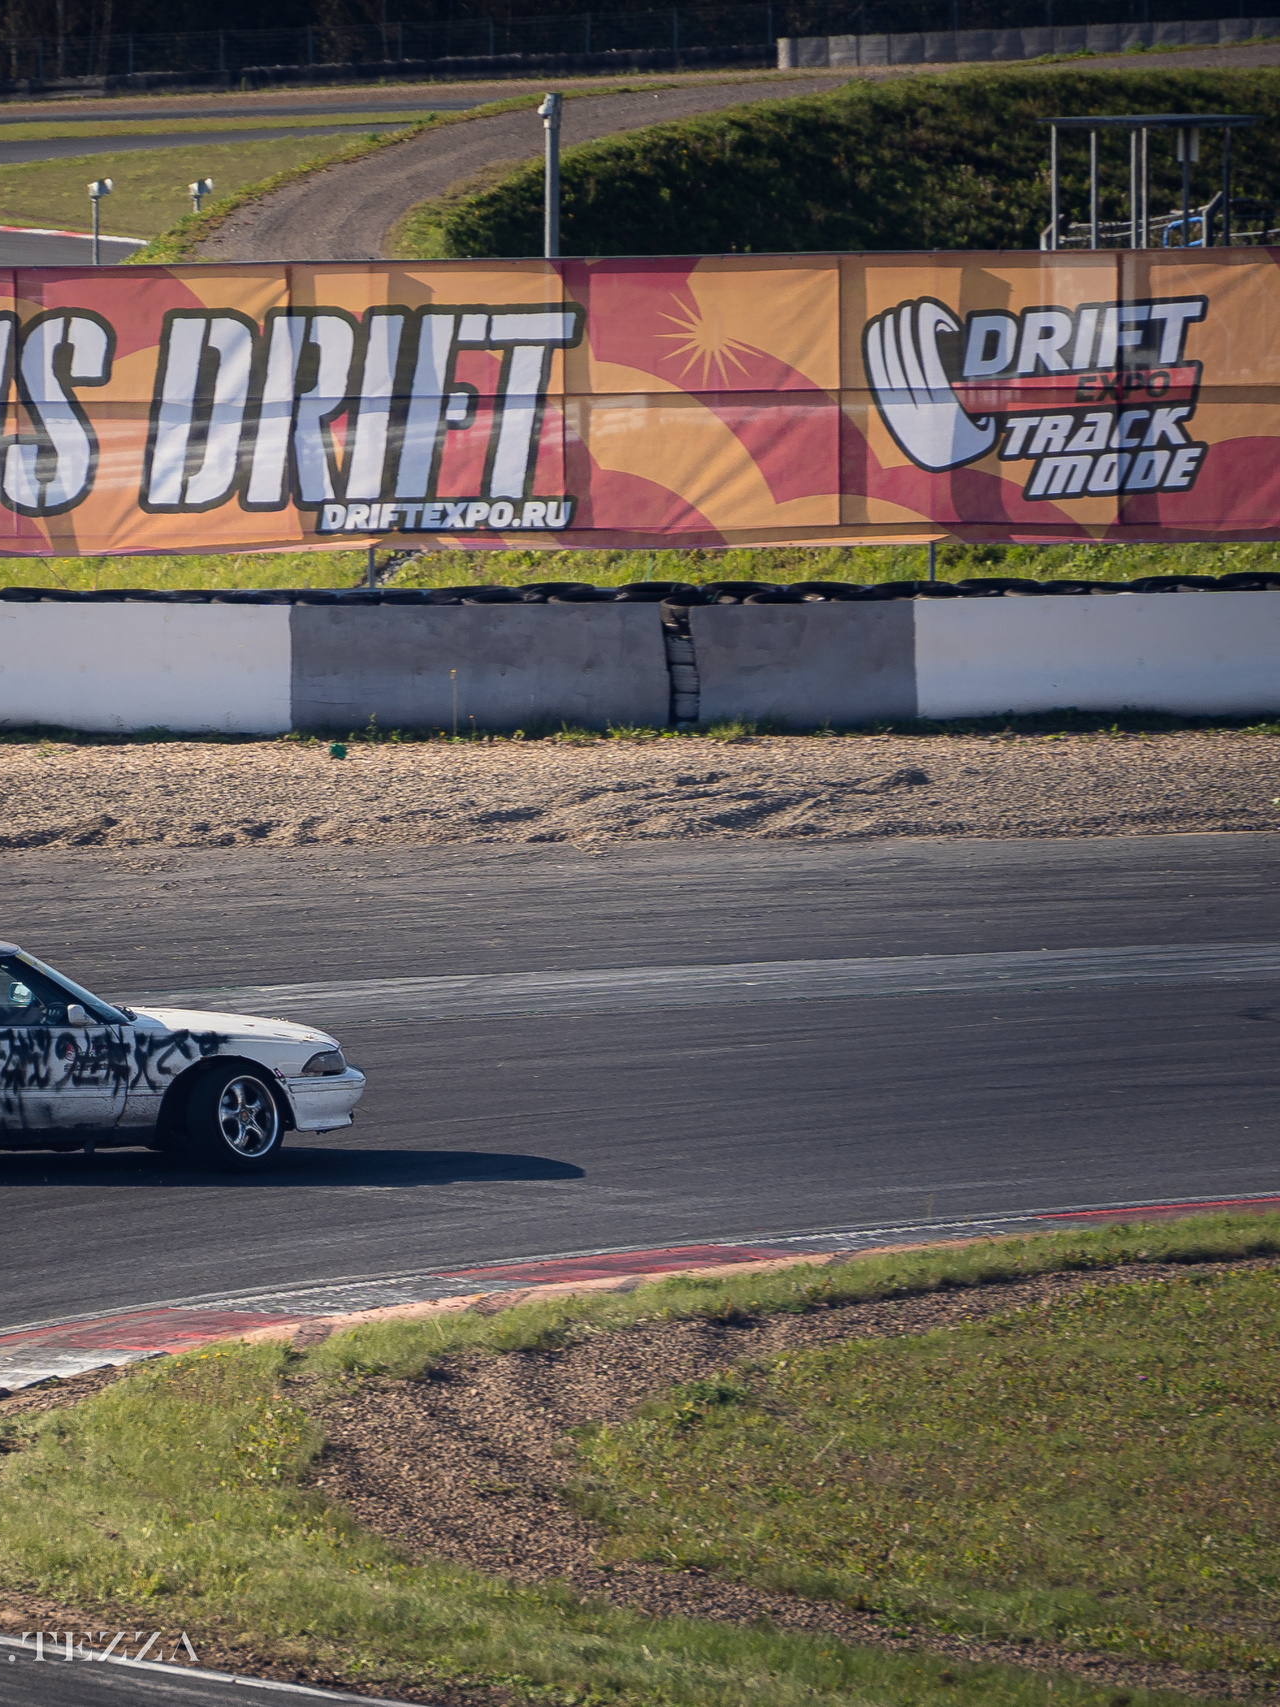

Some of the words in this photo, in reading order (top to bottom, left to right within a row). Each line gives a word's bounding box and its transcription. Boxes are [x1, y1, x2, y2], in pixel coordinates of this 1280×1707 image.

[962, 301, 1204, 377] DRIFT
[141, 304, 584, 511] DRIFT
[1075, 370, 1172, 403] EXPO
[1003, 406, 1191, 456] TRACK
[1028, 447, 1203, 496] MODE
[320, 500, 572, 530] DRIFTEXPO.RU
